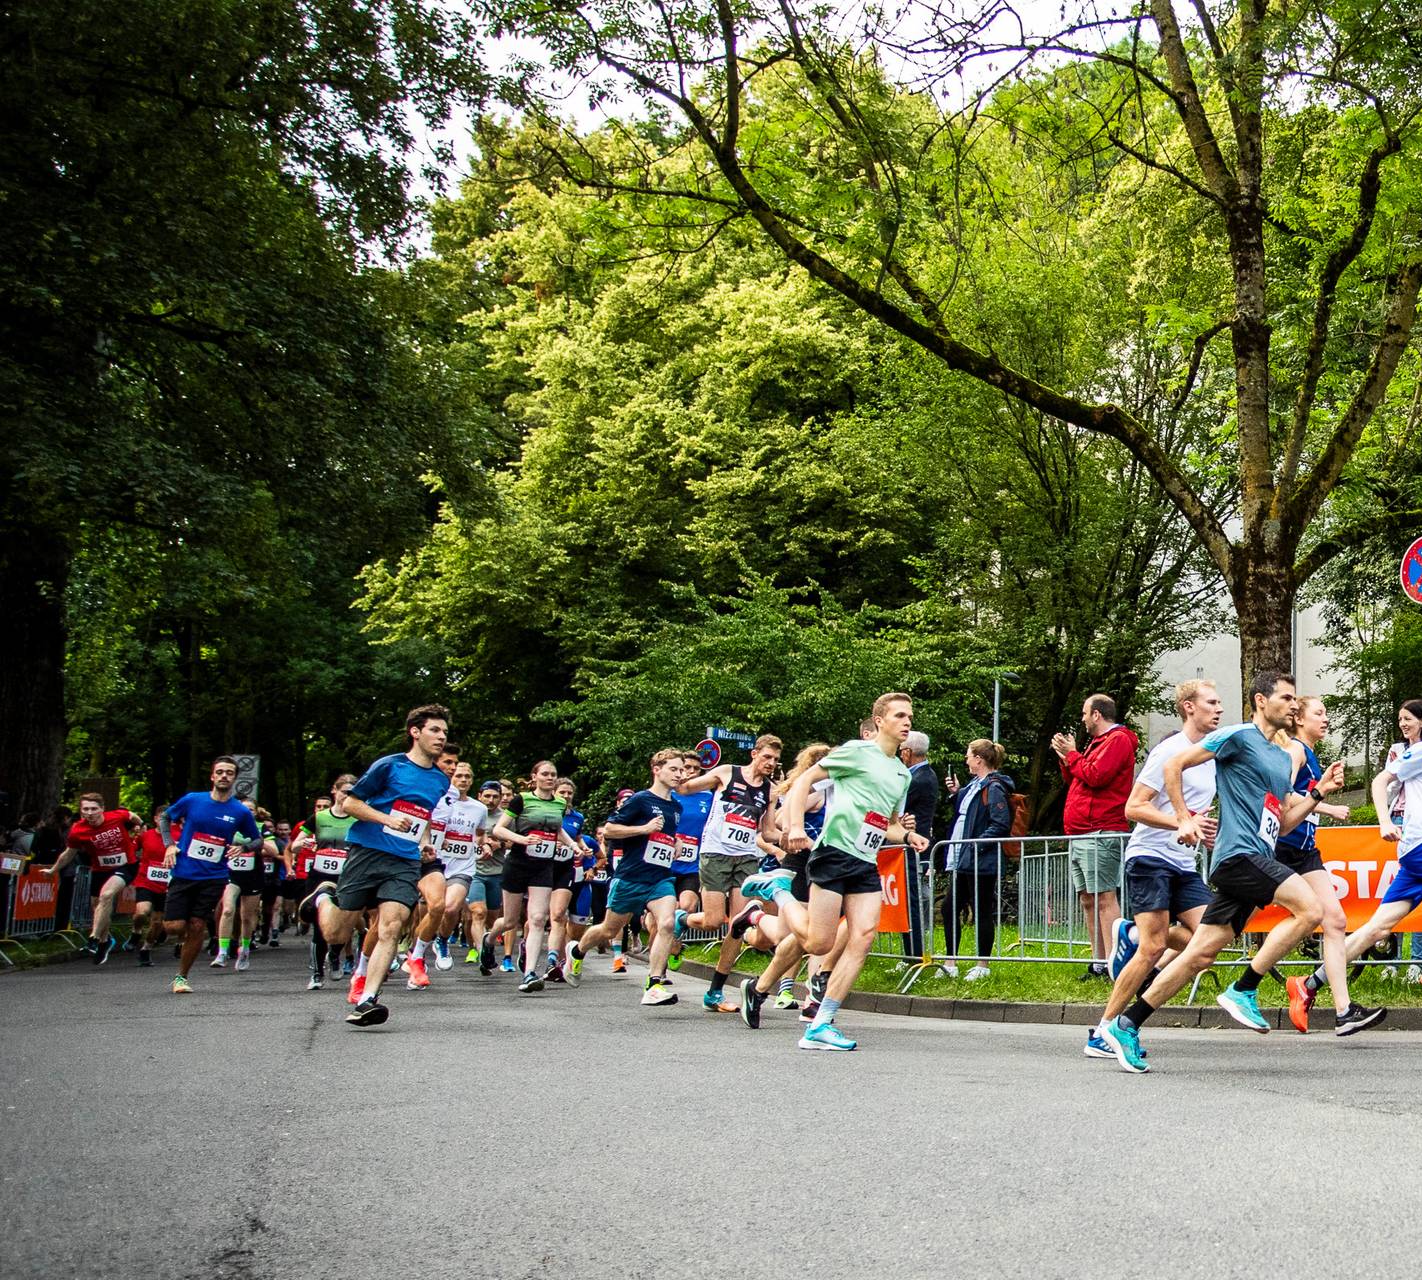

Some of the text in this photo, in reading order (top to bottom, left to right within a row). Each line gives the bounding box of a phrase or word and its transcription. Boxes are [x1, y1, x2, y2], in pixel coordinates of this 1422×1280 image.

[728, 828, 750, 843] 708
[864, 831, 882, 849] 196
[198, 845, 215, 858] 38
[535, 842, 549, 854] 57
[652, 847, 672, 862] 754
[233, 858, 247, 868] 52
[322, 859, 338, 870] 59
